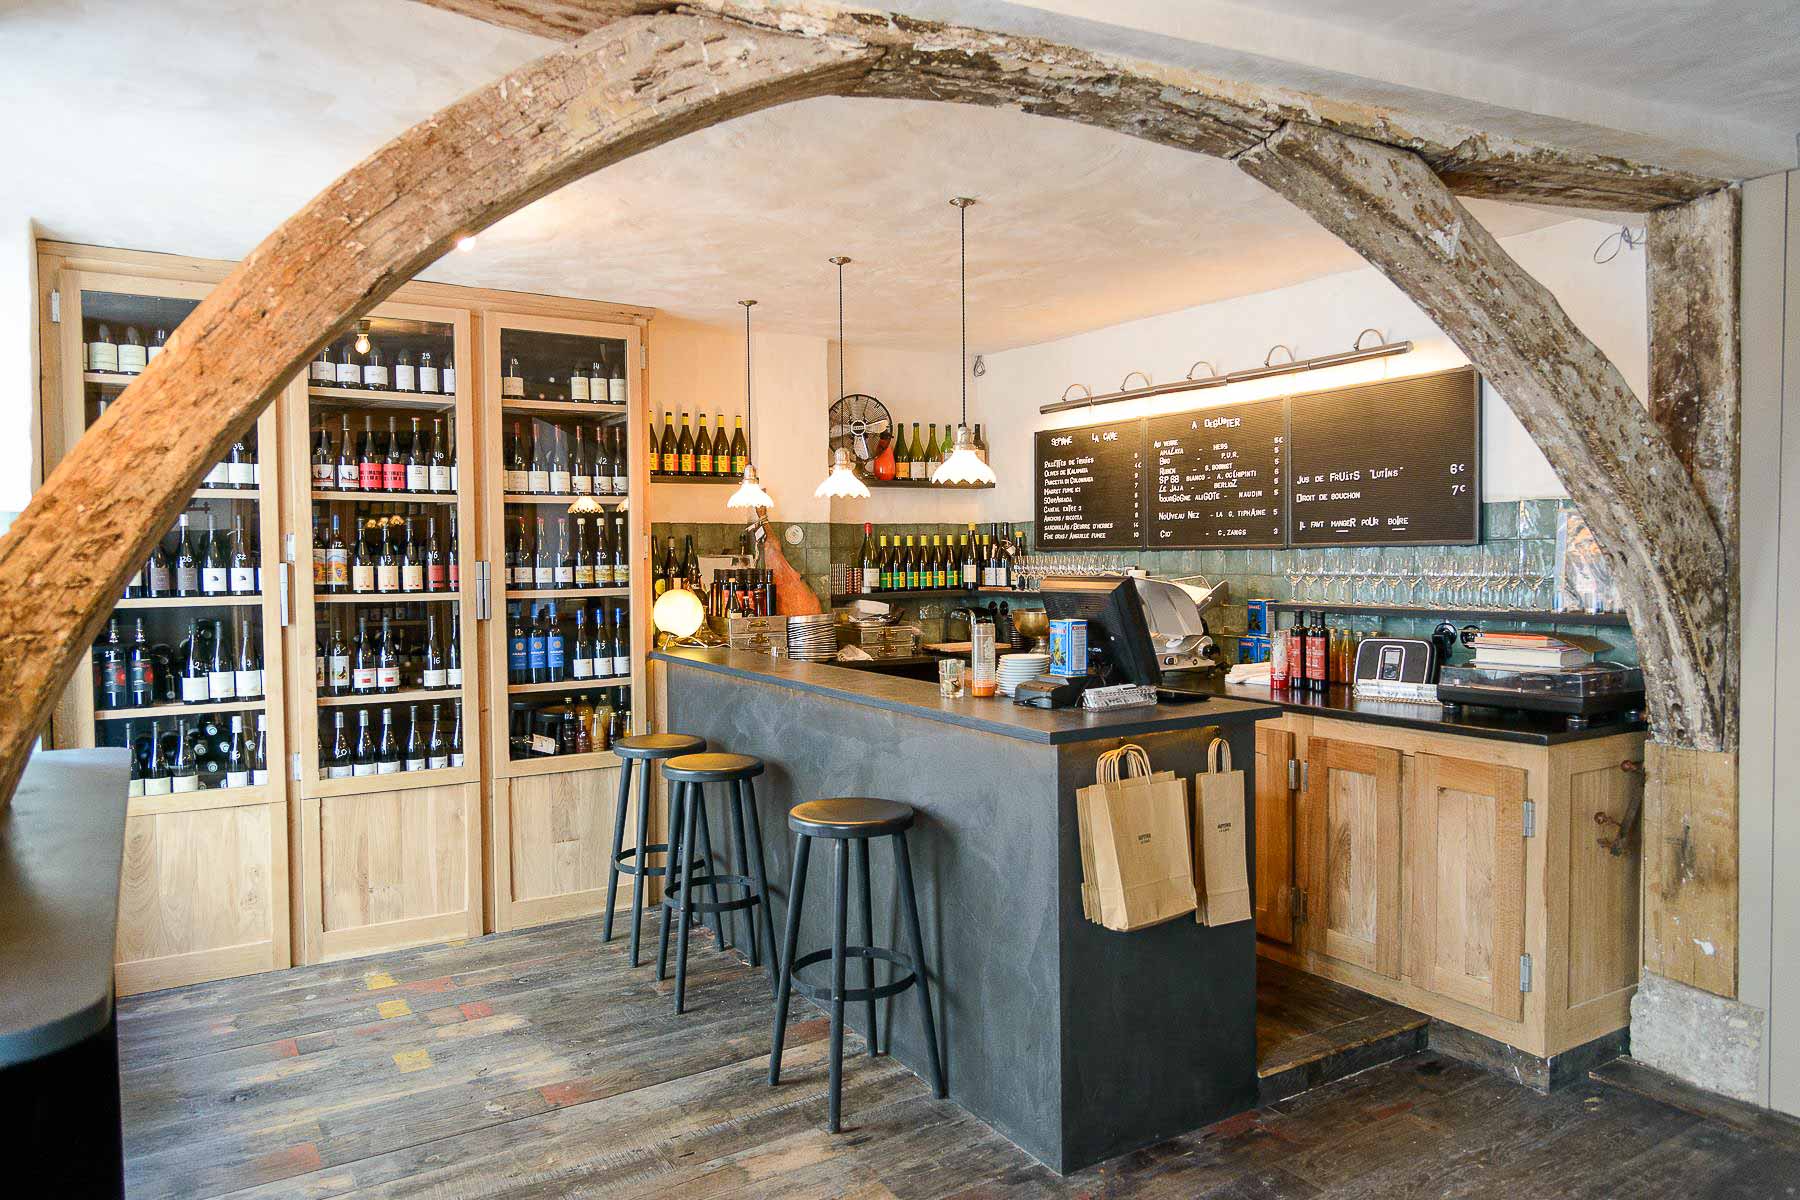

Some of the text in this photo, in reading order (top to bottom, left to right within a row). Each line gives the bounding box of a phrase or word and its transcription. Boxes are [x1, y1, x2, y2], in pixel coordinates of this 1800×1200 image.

[1192, 417, 1241, 429] A DEGUSTER
[1092, 433, 1099, 442] LA
[1103, 432, 1118, 441] CAVE
[1297, 476, 1309, 485] JUS
[1315, 475, 1324, 483] DE
[1330, 471, 1360, 482] FRUITS
[1450, 464, 1464, 474] 6€
[1214, 479, 1237, 489] BERLIOZ
[1296, 484, 1466, 503] DROIT DE BOUCHON 7€
[1159, 512, 1185, 520] NOUVEAU
[1188, 511, 1199, 519] NEZ
[1299, 522, 1305, 530] IL
[1331, 518, 1356, 528] MANGER
[1361, 518, 1379, 526] POUR
[1388, 516, 1409, 526] BOIRE
